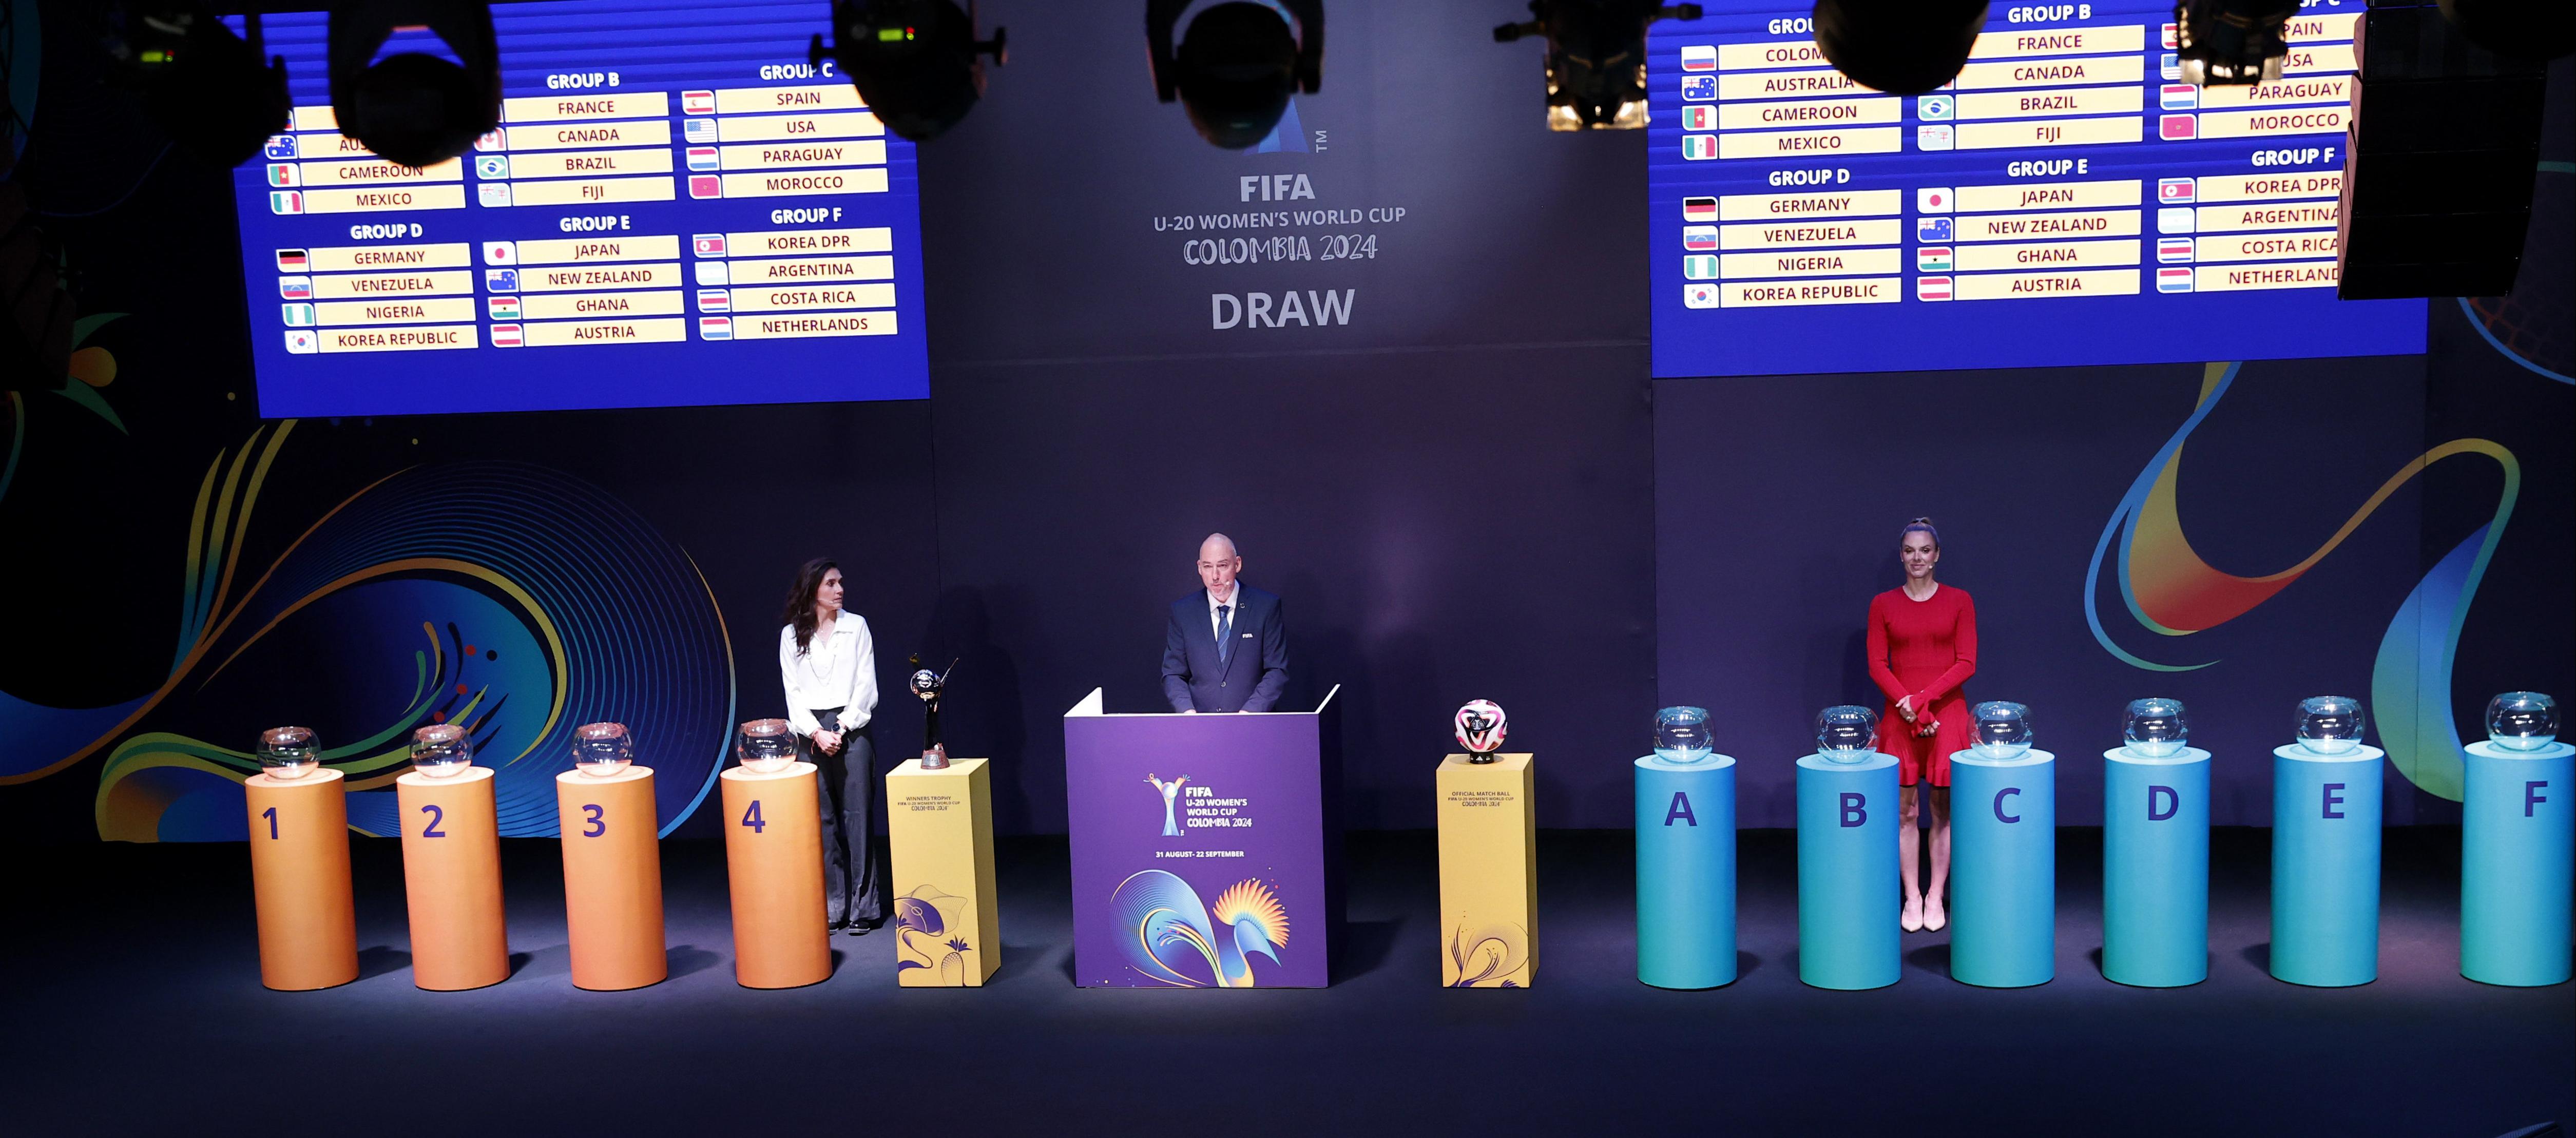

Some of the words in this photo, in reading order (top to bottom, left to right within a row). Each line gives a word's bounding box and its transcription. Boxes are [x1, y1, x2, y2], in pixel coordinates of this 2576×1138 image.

[2008, 5, 2073, 23] GROUP
[2079, 4, 2090, 19] B
[2284, 22, 2322, 35] PAIN
[2018, 35, 2081, 50] FRANCE
[1766, 48, 1824, 62] COLOM
[822, 63, 833, 78] C
[2015, 66, 2084, 80] CANADA
[547, 73, 604, 89] GROUP
[608, 72, 619, 86] B
[1765, 76, 1854, 91] AUSTRALIA
[2250, 83, 2342, 99] PARAGUAY
[777, 93, 820, 105] SPAIN
[2021, 97, 2077, 110] BRAZIL
[559, 101, 614, 113] FRANCE
[1763, 106, 1856, 121] CAMEROON
[787, 121, 815, 133] USA
[2251, 114, 2338, 129] MOROCCO
[559, 129, 619, 142] CANADA
[1316, 131, 1327, 152] TM
[2037, 127, 2060, 142] FIJI
[1779, 137, 1840, 150] MEXICO
[764, 148, 842, 162] PARAGUAY
[2252, 148, 2319, 166] GROUP
[2324, 147, 2334, 163] F
[566, 158, 616, 170] BRAZIL
[2008, 160, 2072, 177] GROUP
[2078, 159, 2087, 173] E
[339, 165, 424, 179] CAMEROON
[1769, 169, 1832, 186] GROUP
[1838, 169, 1850, 183] D
[767, 177, 842, 190] MOROCCO
[1241, 174, 1315, 201] FIFA
[2246, 180, 2301, 194] KOREA
[2308, 178, 2340, 191] DPR
[357, 194, 411, 205] MEXICO
[583, 186, 603, 200] FIJI
[2021, 189, 2073, 206] JAPAN
[1771, 198, 1850, 213] GERMANY
[772, 208, 829, 224] GROUP
[833, 208, 841, 221] F
[1155, 216, 1194, 231] U-20
[1294, 209, 1362, 225] WORLD
[1369, 207, 1405, 222] CUP
[351, 224, 407, 239] GROUP
[411, 224, 422, 237] D
[560, 216, 617, 232] GROUP
[621, 216, 630, 229] E
[1989, 221, 2026, 234] NEW
[2031, 218, 2106, 232] ZEALAND
[1764, 227, 1856, 242] VENEZUELA
[768, 237, 817, 249] KOREA
[822, 236, 850, 247] DPR
[1184, 236, 1311, 264] COLOMBIA
[1320, 234, 1378, 260] 2024
[2242, 240, 2296, 254] COSTA
[355, 252, 424, 264] GERMANY
[575, 244, 620, 259] JAPAN
[2017, 249, 2077, 262] GHANA
[769, 264, 854, 277] ARGENTINA
[1779, 257, 1842, 270] NIGERIA
[352, 279, 433, 291] VENEZUELA
[549, 273, 581, 284] NEW
[586, 271, 651, 283] ZEALAND
[2012, 278, 2081, 292] AUSTRIA
[771, 293, 817, 304] COSTA
[823, 292, 855, 302] RICA
[1744, 288, 1796, 300] KOREA
[1802, 285, 1877, 298] REPUBLIC
[367, 306, 424, 318] NIGERIA
[577, 299, 628, 311] GHANA
[1213, 289, 1355, 329] DRAW
[575, 326, 635, 338] AUSTRIA
[763, 319, 868, 332] NETHERLANDS
[339, 335, 386, 346] KOREA
[390, 332, 457, 344] REPUBLIC
[1186, 787, 1213, 797] FIFA
[2525, 781, 2548, 817] F
[1994, 788, 2021, 823] C
[2148, 786, 2179, 820] D
[2322, 783, 2345, 818] E
[1664, 792, 1697, 826] A
[1840, 793, 1867, 827] B
[263, 807, 278, 839] 1
[421, 805, 445, 837] 2
[582, 804, 605, 837] 3
[742, 801, 765, 833] 4
[1187, 818, 1230, 827] COLOMBIA
[1233, 818, 1252, 827] 2024
